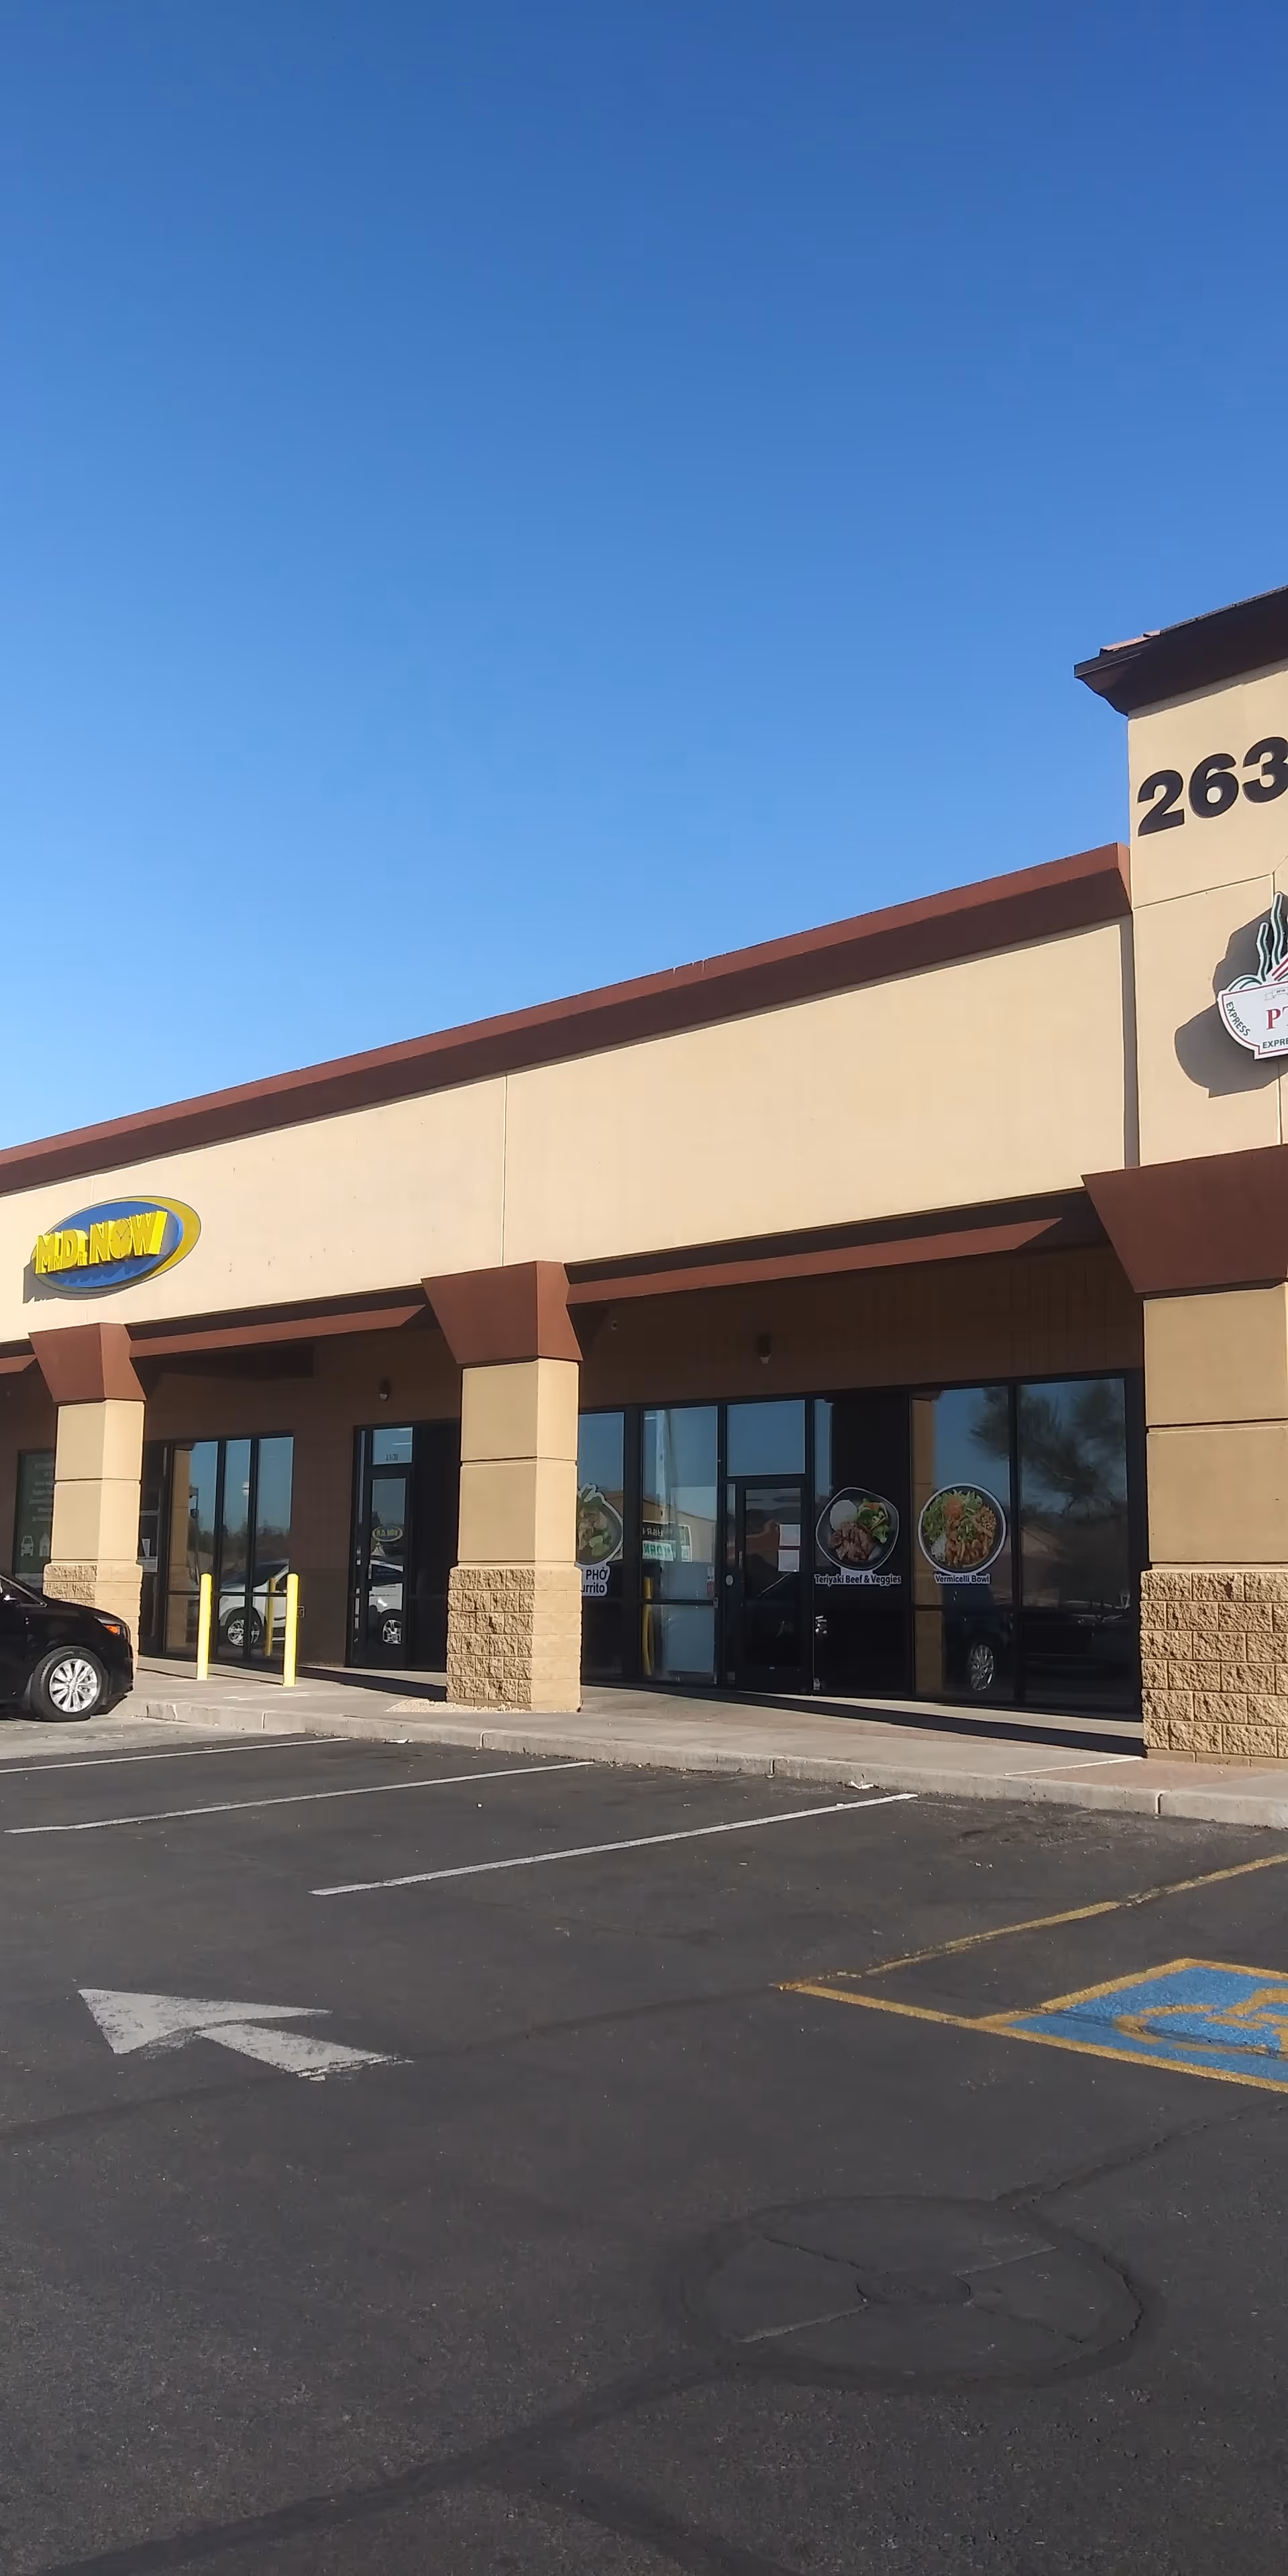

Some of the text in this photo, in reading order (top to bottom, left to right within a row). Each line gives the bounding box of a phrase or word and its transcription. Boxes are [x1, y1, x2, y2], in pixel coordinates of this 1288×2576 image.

[1137, 737, 1288, 837] 263
[1226, 1002, 1250, 1036] EXPRESS
[89, 1210, 168, 1265] NOW
[581, 1582, 605, 1593] urrito
[816, 1574, 902, 1585] Teriyaki Beef & Veggies
[935, 1574, 989, 1583] Vermicelli Bowl
